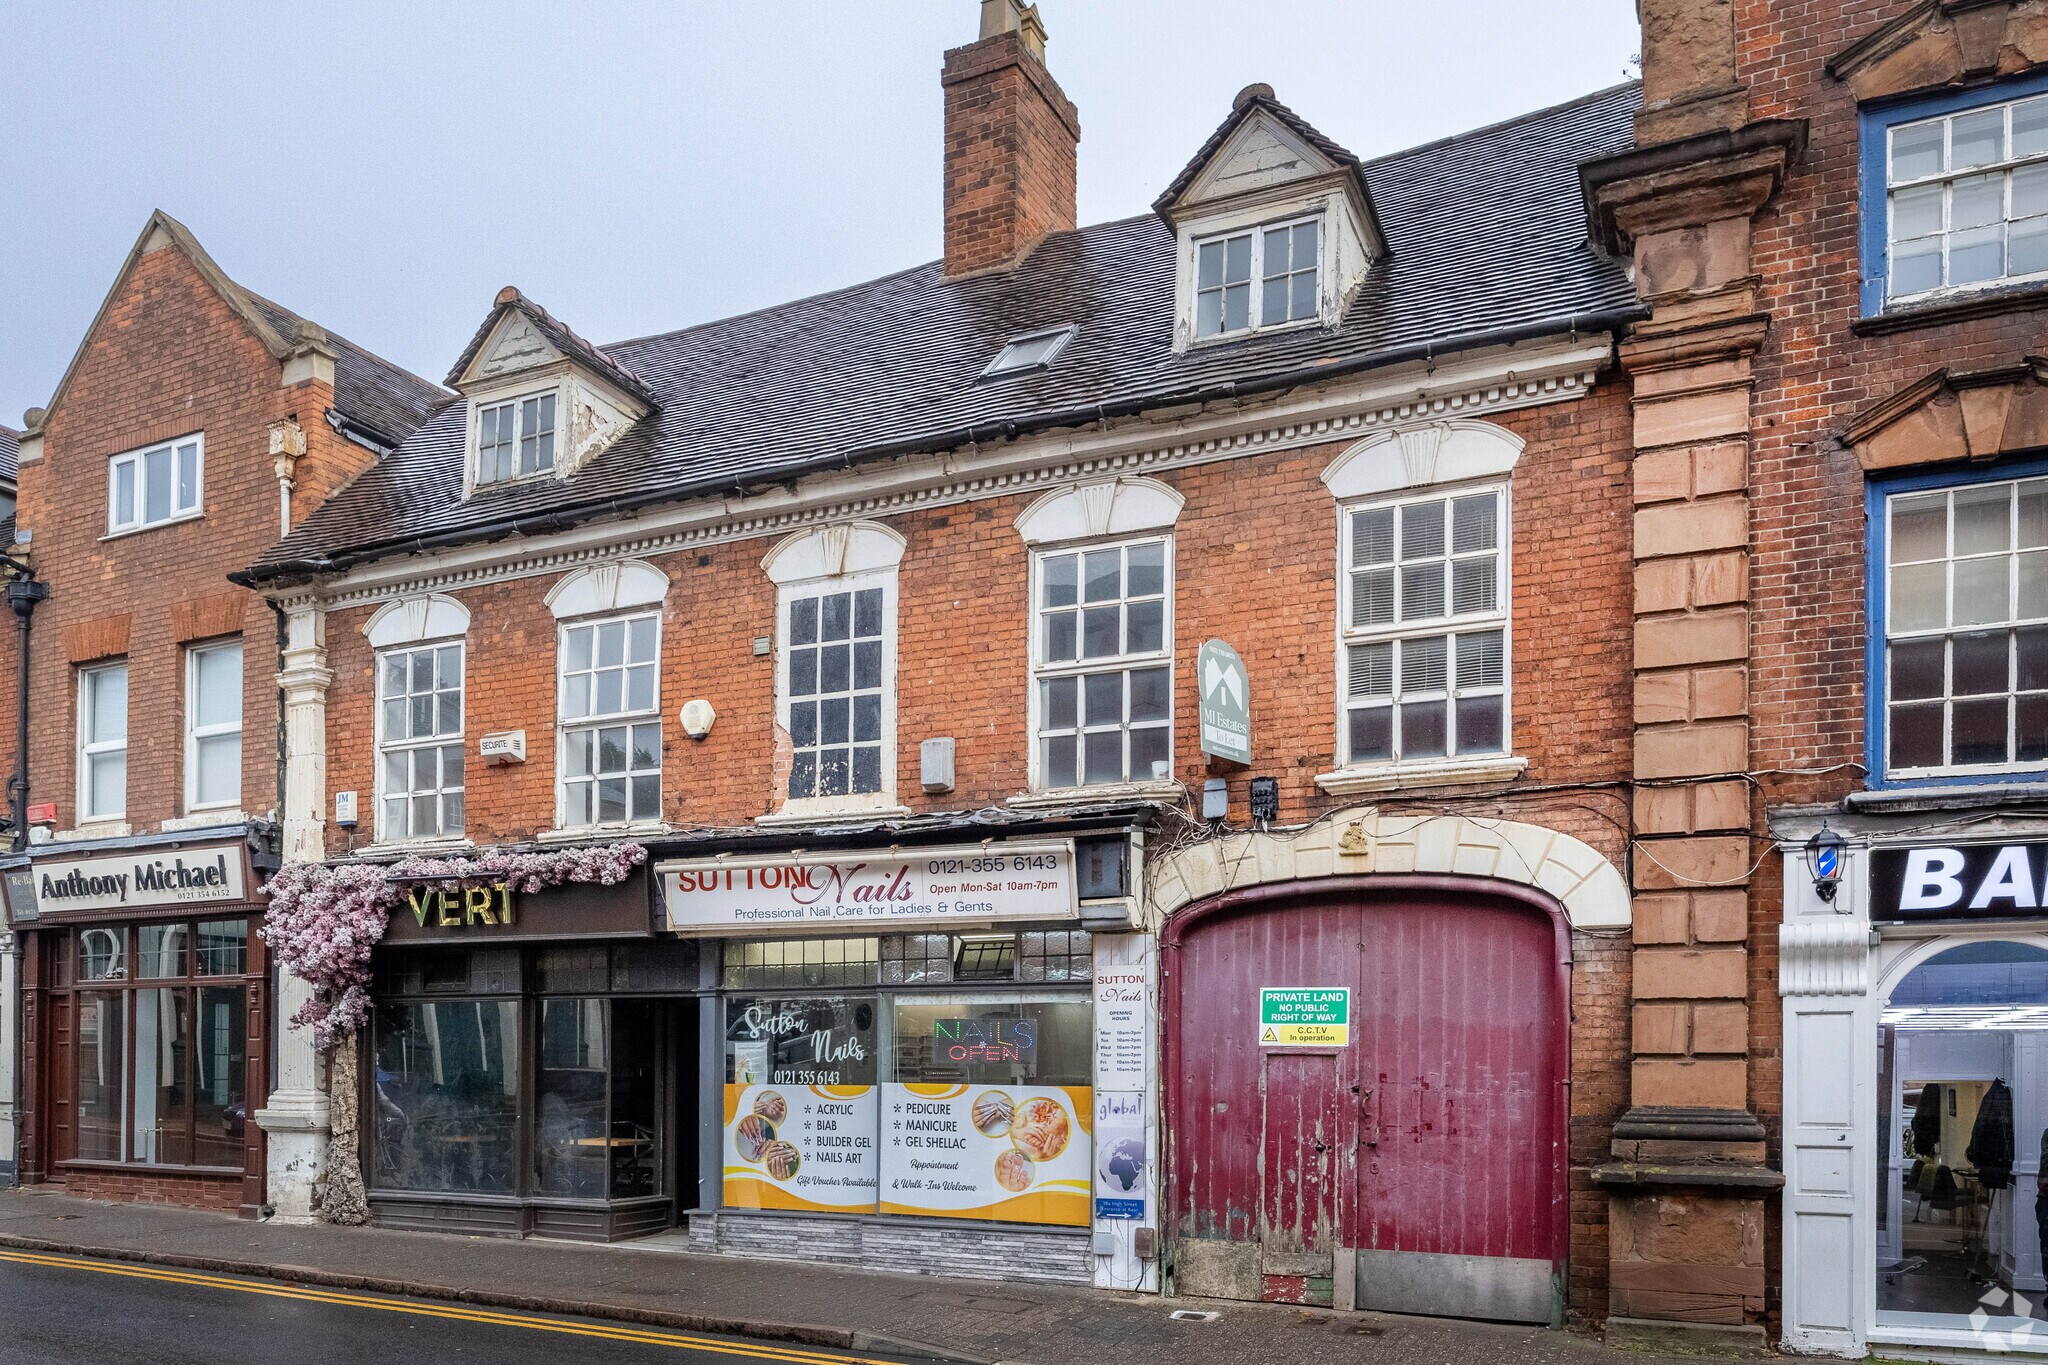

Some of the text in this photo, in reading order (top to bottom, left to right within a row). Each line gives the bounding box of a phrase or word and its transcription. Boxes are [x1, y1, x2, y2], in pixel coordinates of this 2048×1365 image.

[1204, 707, 1247, 734] MI Estates
[1216, 730, 1236, 746] To Let
[337, 793, 349, 804] JM
[928, 855, 1057, 875] 0121-355 6143
[41, 868, 129, 902] Anthony
[134, 854, 227, 892] Michael
[678, 863, 914, 905] SUTTON Nails
[1899, 846, 2048, 910] BA
[929, 880, 1058, 895] Open Mon-Sat 10am-7pm
[177, 889, 230, 900] 0121 354 6152
[408, 883, 513, 928] VERT
[735, 901, 993, 919] Professional Nail Care for Ladies & Gents
[1097, 975, 1145, 985] SUTTON
[1100, 988, 1142, 1002] Nails
[1265, 992, 1344, 1002] PRIVATE LAND
[1279, 1003, 1329, 1012] NO PUBLIC
[744, 1006, 809, 1039] Sutton
[1271, 1013, 1337, 1021] RIGHT OF WAY
[936, 1021, 1033, 1049] NAILS
[1297, 1026, 1328, 1034] C.C.T.V
[1298, 1034, 1335, 1042] operation
[810, 1030, 865, 1063] Nails
[949, 1045, 1019, 1061] OPEN
[774, 1070, 840, 1085] 0121 355 6143
[816, 1103, 854, 1115] ACRYLIC
[906, 1103, 951, 1115] PEDICURE
[816, 1120, 837, 1131] BIAB
[905, 1119, 957, 1132] MANICURE
[816, 1136, 872, 1148] BUILDER GEL
[905, 1136, 967, 1149] GEL SHELLAC
[816, 1151, 862, 1164] NAILS ART
[910, 1158, 959, 1171] Appointment
[797, 1175, 878, 1187] Gift Voucher Available
[892, 1178, 899, 1189] &
[900, 1178, 923, 1189] Walk
[941, 1180, 977, 1191] Welcome
